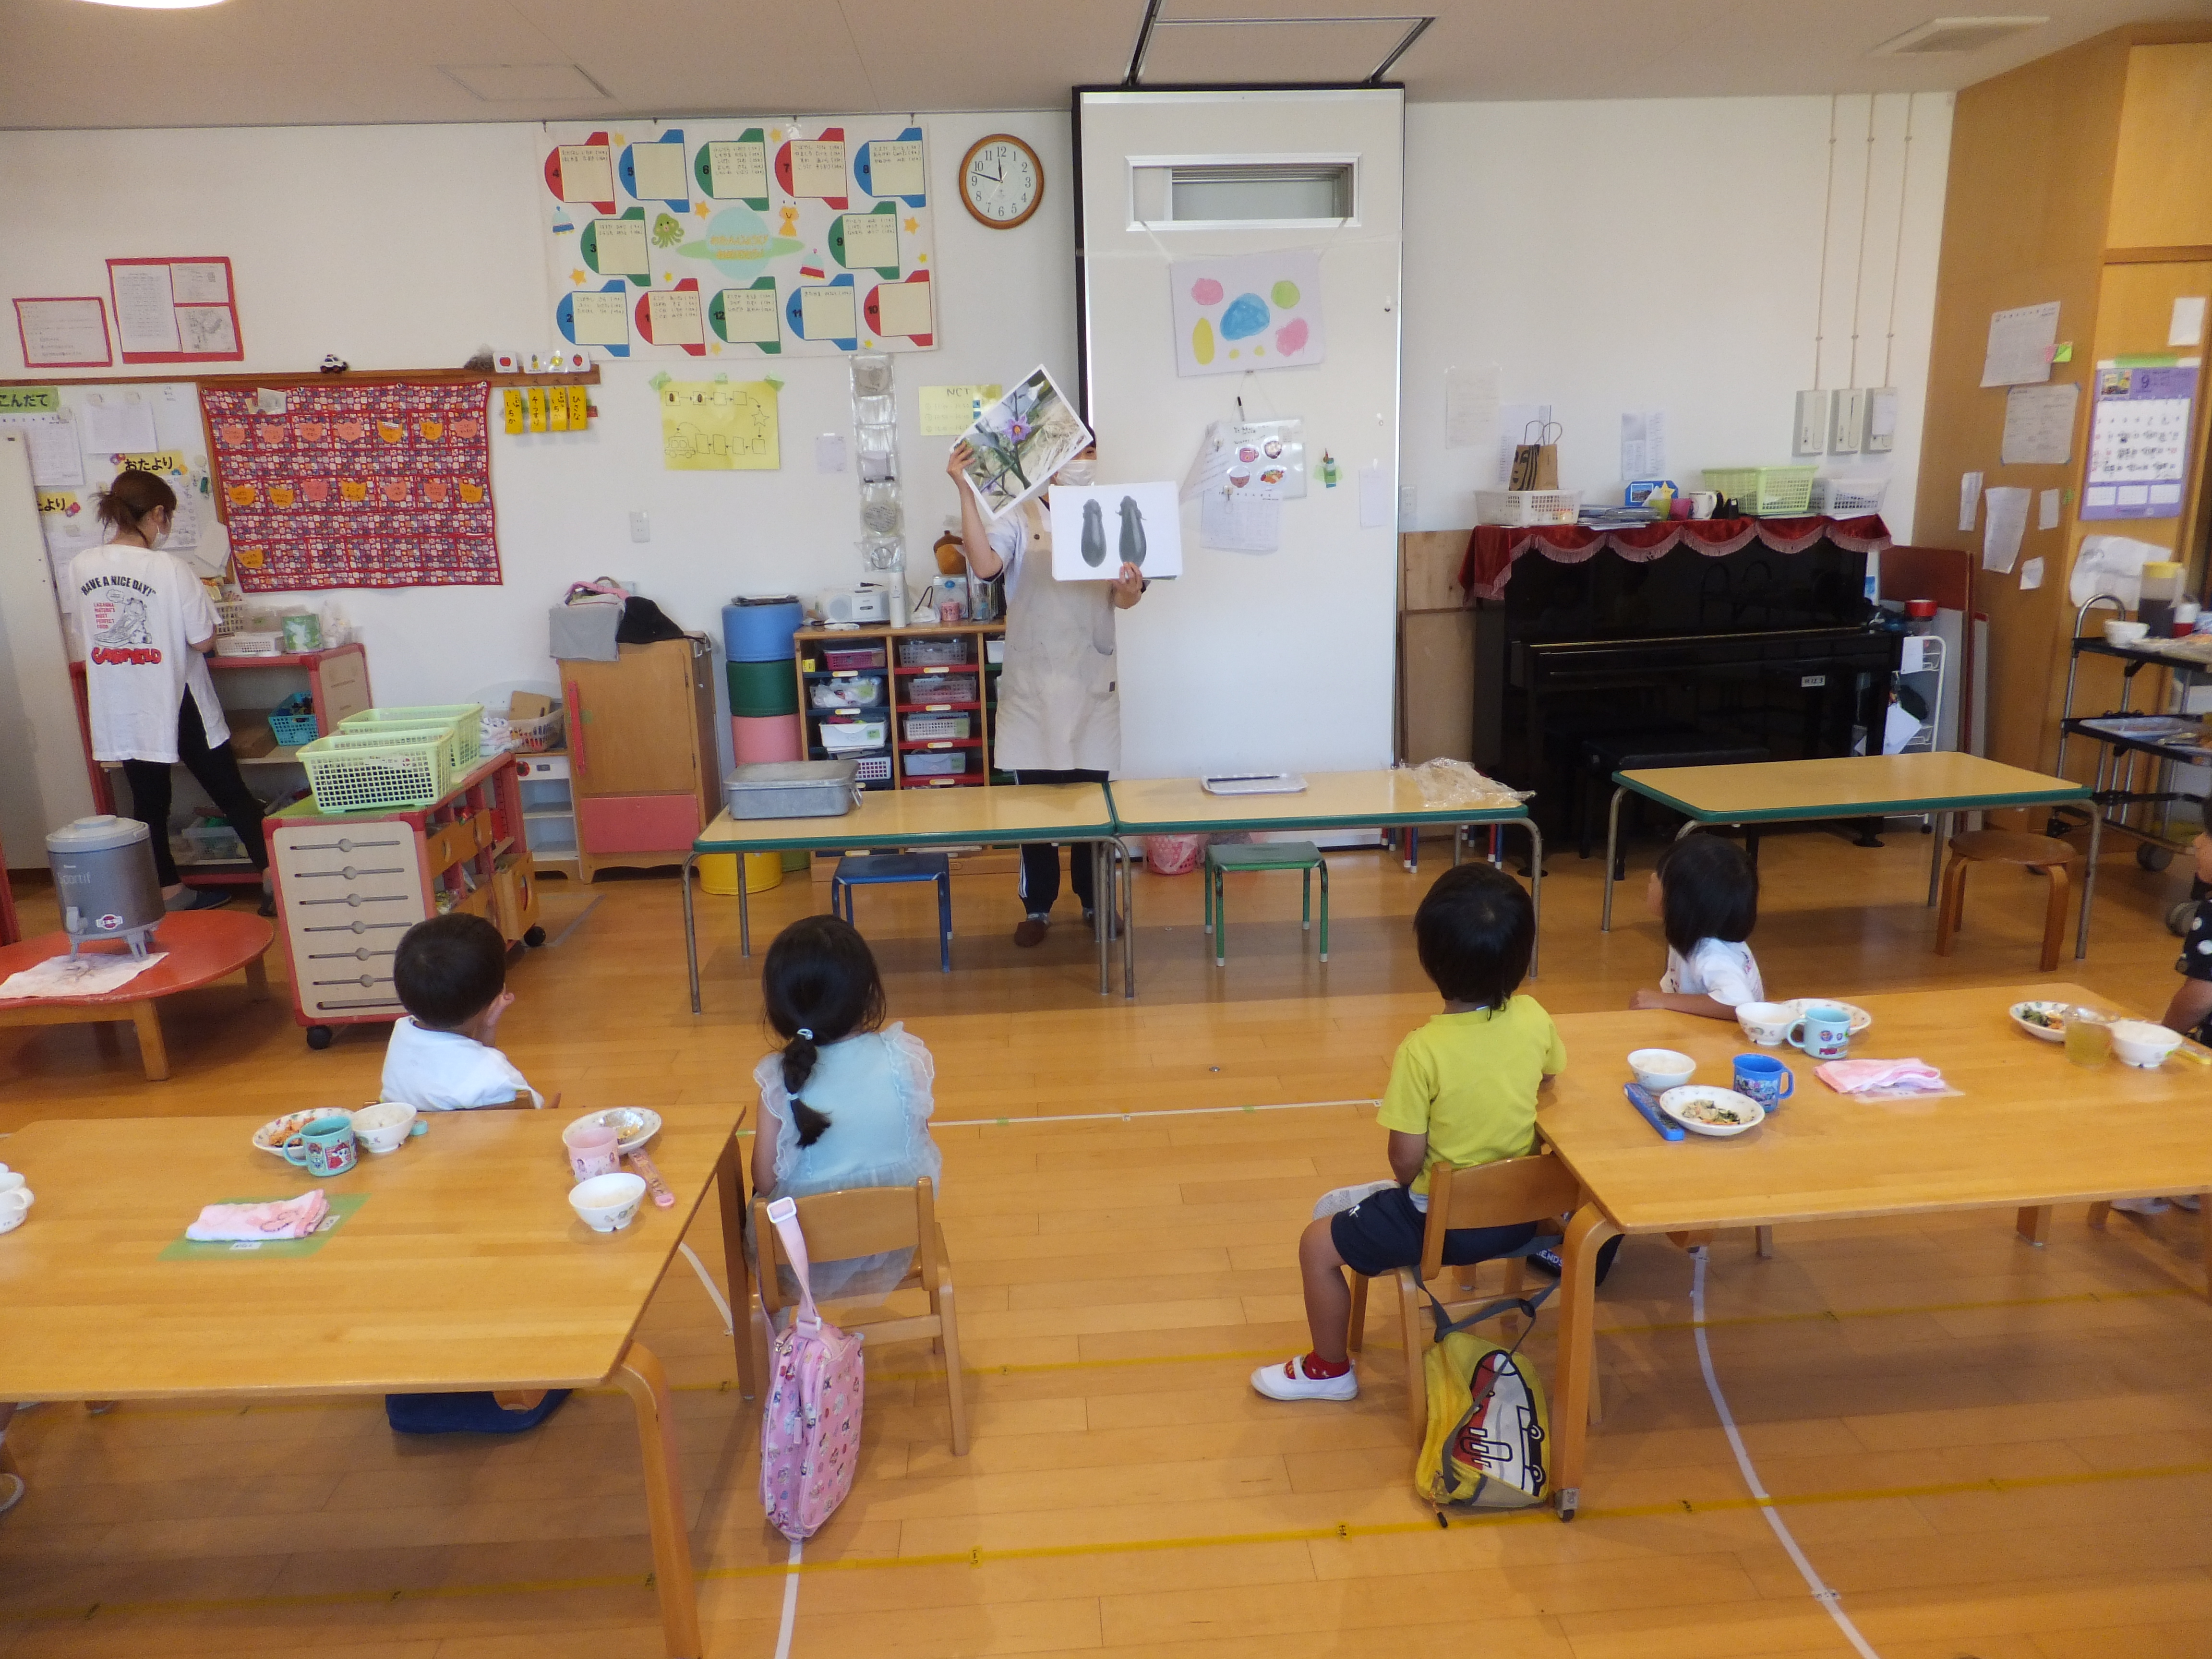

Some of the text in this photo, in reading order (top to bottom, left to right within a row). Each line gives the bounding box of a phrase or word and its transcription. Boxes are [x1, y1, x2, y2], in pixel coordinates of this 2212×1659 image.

[986, 150, 992, 161] 11
[997, 146, 1007, 157] 12
[1013, 151, 1016, 161] 1
[702, 165, 710, 174] 6
[783, 163, 790, 173] 7
[974, 161, 983, 171] 10
[1022, 162, 1027, 172] 2
[972, 176, 977, 186] 9
[1025, 177, 1031, 188] 3
[975, 191, 982, 202] 8
[1021, 192, 1027, 202] 4
[986, 202, 991, 213] 7
[998, 206, 1004, 216] 6
[1011, 203, 1017, 214] 5
[836, 237, 843, 246] 9
[590, 244, 597, 252] 3
[868, 305, 878, 314] 10
[714, 311, 725, 320] 12
[947, 388, 970, 397] NCT
[0, 394, 48, 407] こんだて
[124, 456, 172, 471] おたより
[81, 577, 102, 596] HAVE
[103, 577, 109, 586] A
[111, 576, 131, 587] NICE
